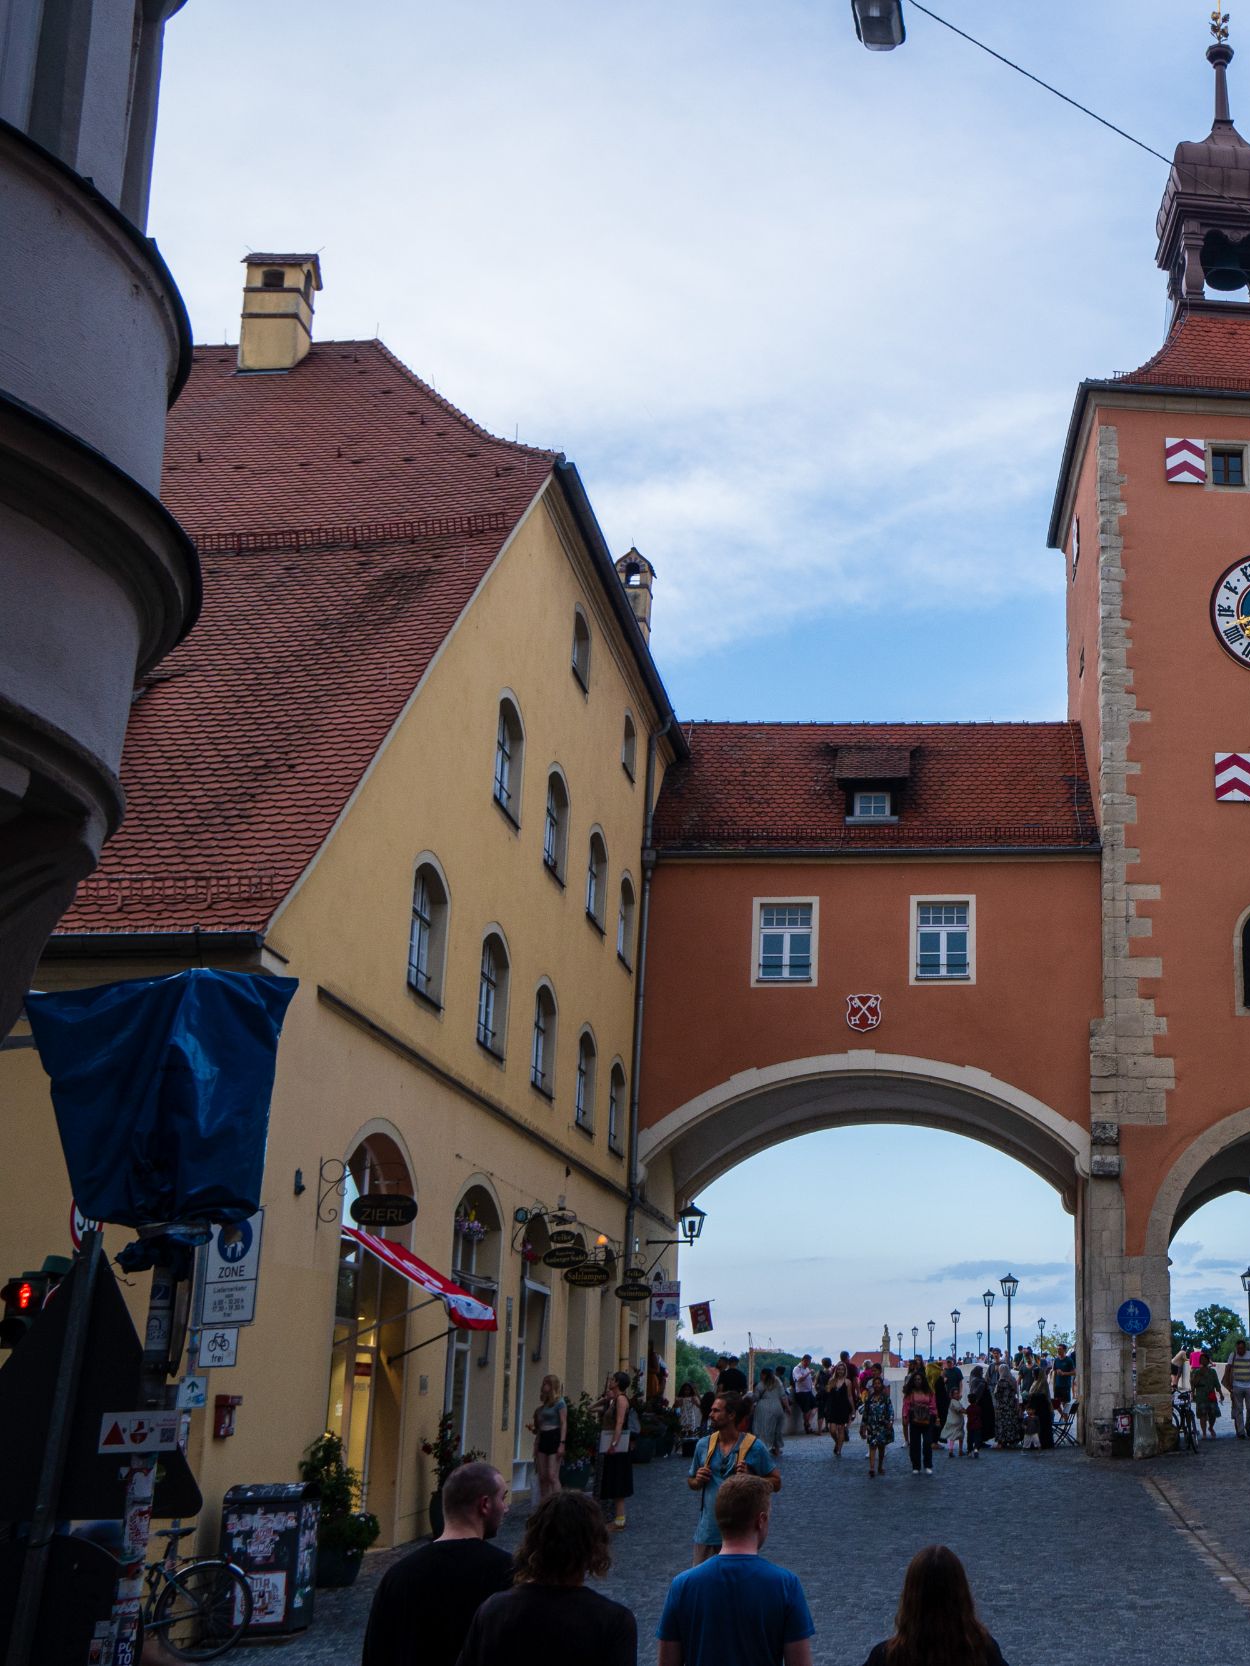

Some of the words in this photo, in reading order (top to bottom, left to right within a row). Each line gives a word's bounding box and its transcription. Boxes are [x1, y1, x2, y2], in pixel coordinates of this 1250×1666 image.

[360, 1207, 407, 1221] ZIERL
[218, 1265, 245, 1279] ZONE
[211, 1353, 224, 1364] frei
